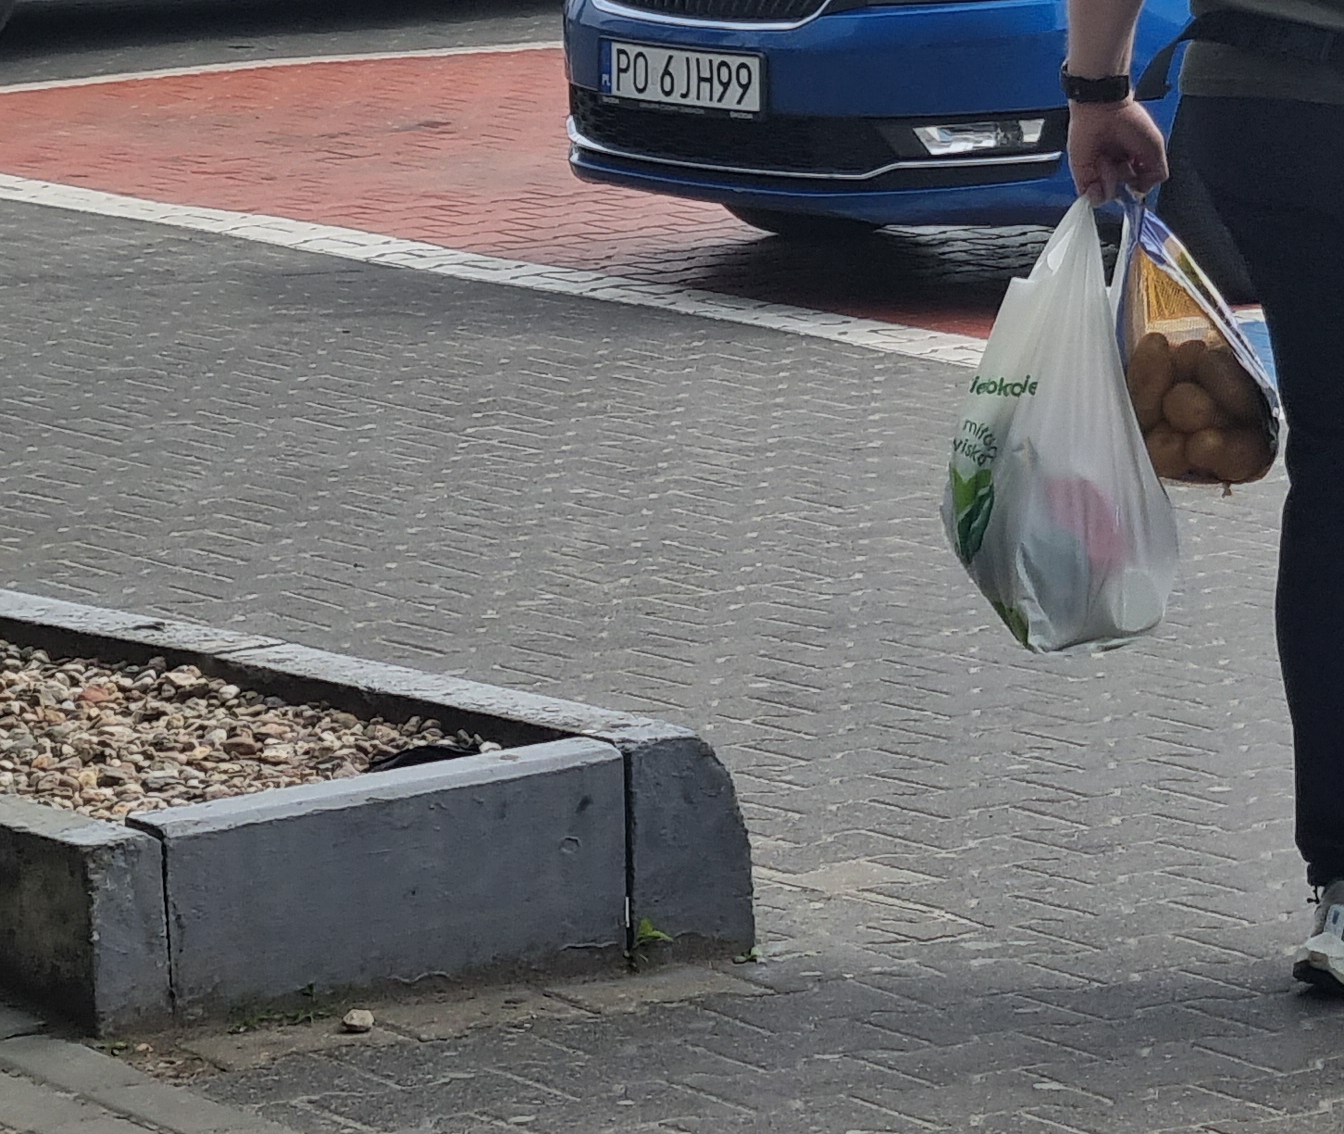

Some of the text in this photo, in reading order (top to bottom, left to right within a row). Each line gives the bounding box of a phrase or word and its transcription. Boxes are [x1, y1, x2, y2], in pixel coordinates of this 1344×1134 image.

[601, 73, 611, 86] PL
[616, 48, 752, 105] PO 6JH99
